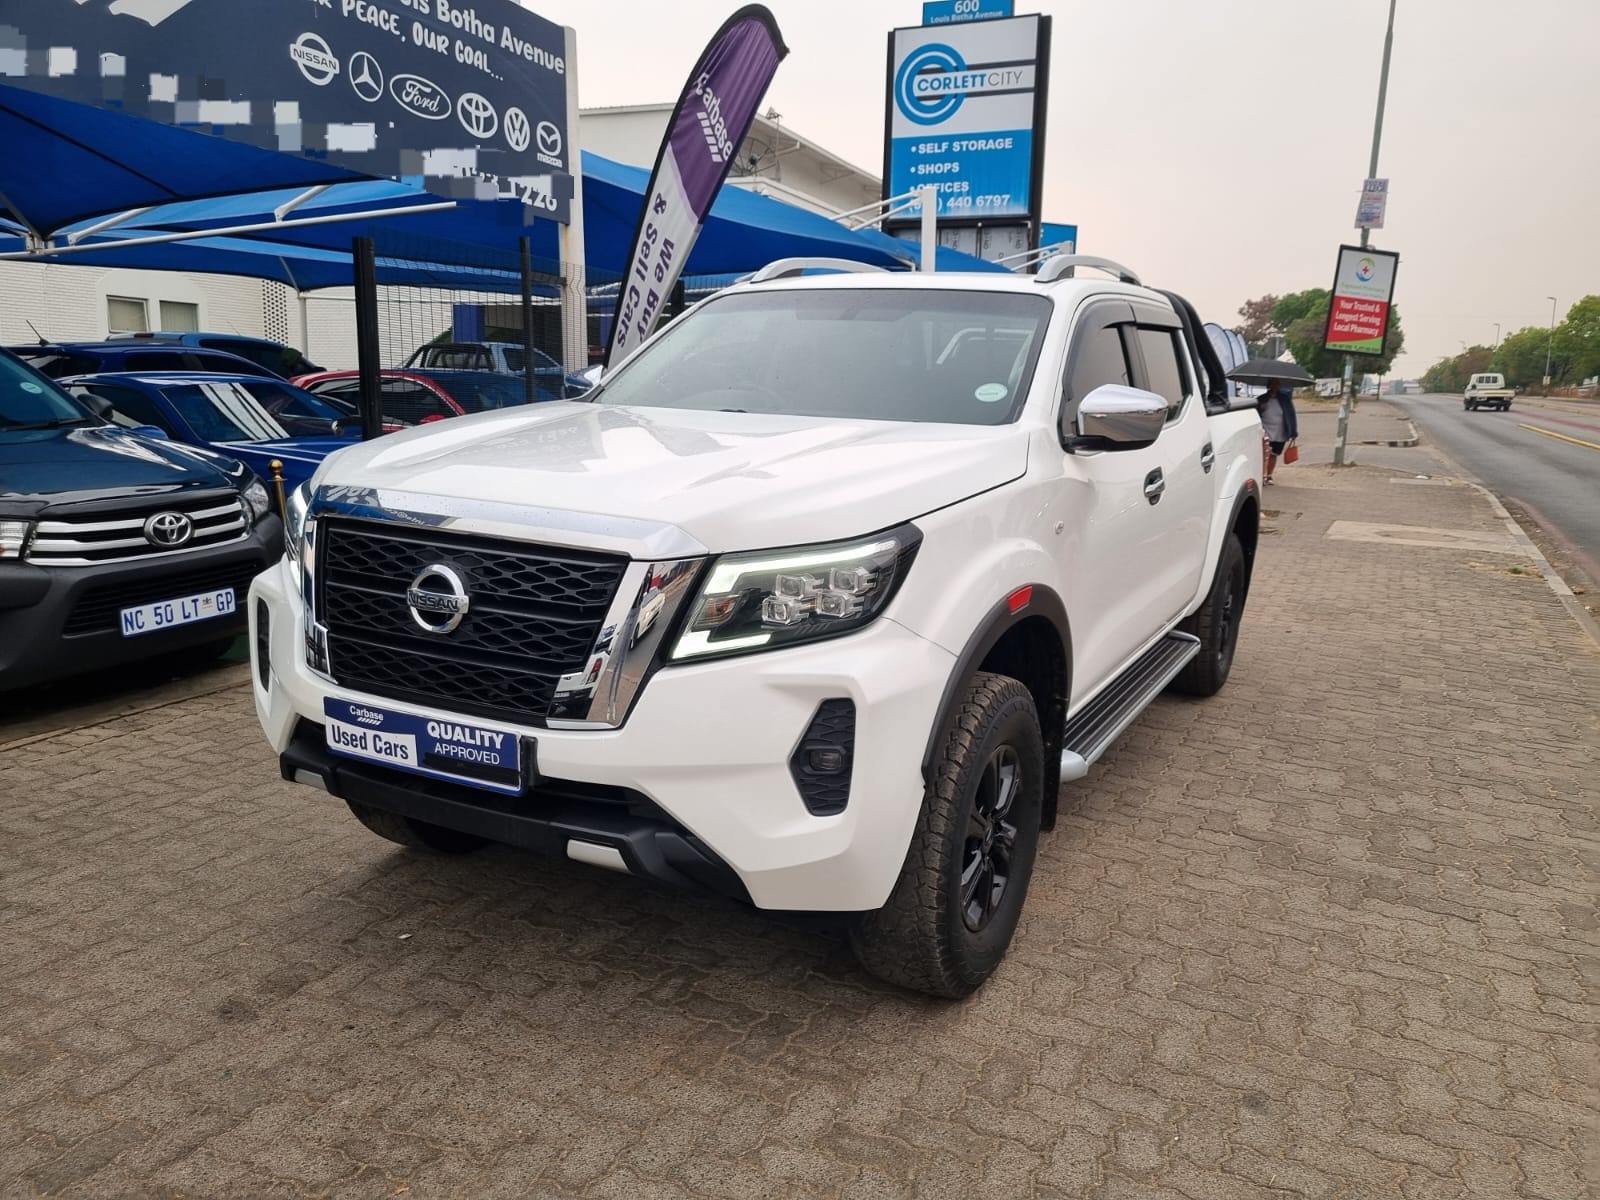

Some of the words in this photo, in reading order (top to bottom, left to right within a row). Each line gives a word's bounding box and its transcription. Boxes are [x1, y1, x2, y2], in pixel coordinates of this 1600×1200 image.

[930, 14, 950, 24] Louis
[974, 9, 1003, 20] Avenue
[954, 0, 980, 14] 600
[412, 22, 450, 56] OUR
[437, 0, 495, 44] Botha
[501, 26, 565, 74] Avenue
[293, 47, 338, 71] NISSAN
[402, 80, 441, 113] Ford
[918, 142, 949, 154] SELF
[952, 137, 1013, 152] STORAGE
[917, 162, 960, 175] SHOPS
[946, 196, 972, 209] 440
[976, 194, 1011, 208] 6797
[635, 222, 658, 282] Sell
[654, 237, 675, 284] We
[617, 284, 641, 348] Cars
[123, 609, 145, 633] NC
[153, 603, 174, 626] 50
[181, 598, 199, 620] LT
[216, 591, 233, 612] GP
[408, 591, 459, 613] NISSAN
[350, 704, 384, 721] Carbase
[332, 724, 368, 751] Used
[373, 733, 409, 761] Cars
[426, 720, 504, 749] QUALITY
[434, 741, 500, 765] APPROVED
